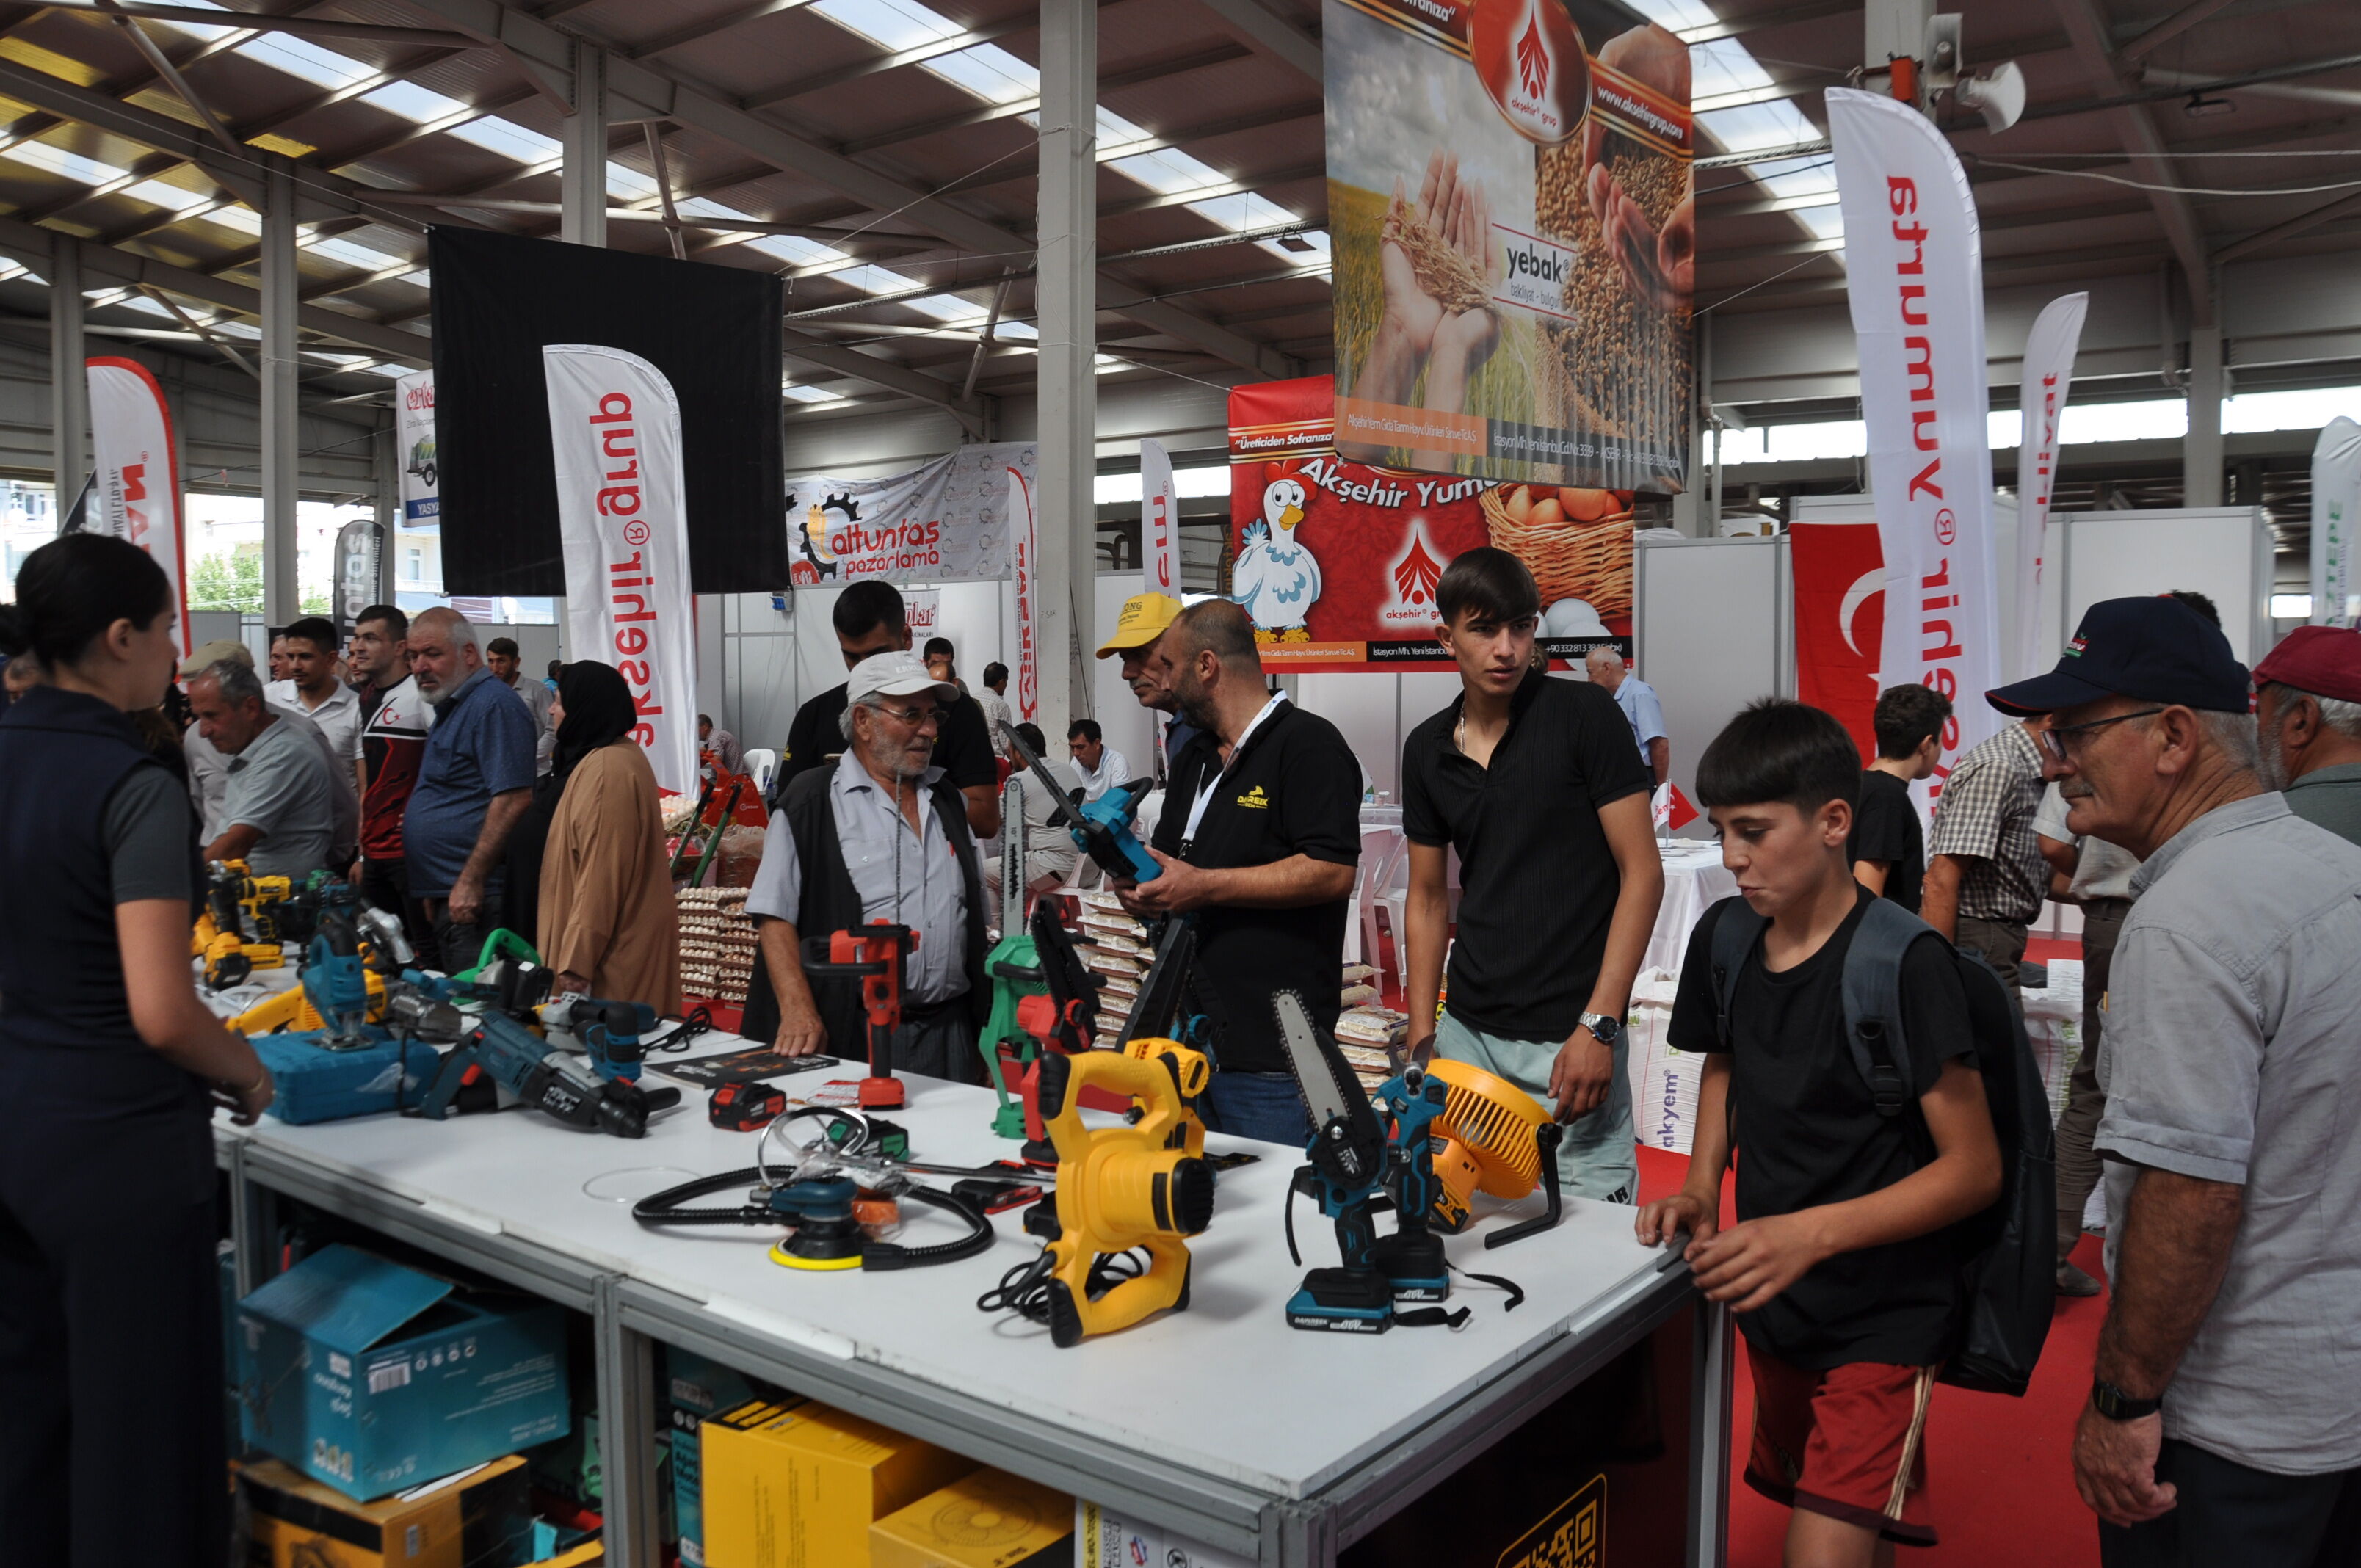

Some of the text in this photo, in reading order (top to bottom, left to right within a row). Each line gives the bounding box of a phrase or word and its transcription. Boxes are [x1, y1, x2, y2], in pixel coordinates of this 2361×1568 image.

[1542, 112, 1558, 128] grup
[1299, 457, 1410, 508] Akşehir
[831, 518, 940, 556] altuntaş
[846, 550, 940, 580] pazarlama
[1385, 608, 1427, 620] akşehir®
[1373, 645, 1398, 658] İstasyon
[1657, 1068, 1680, 1148] akyem®
